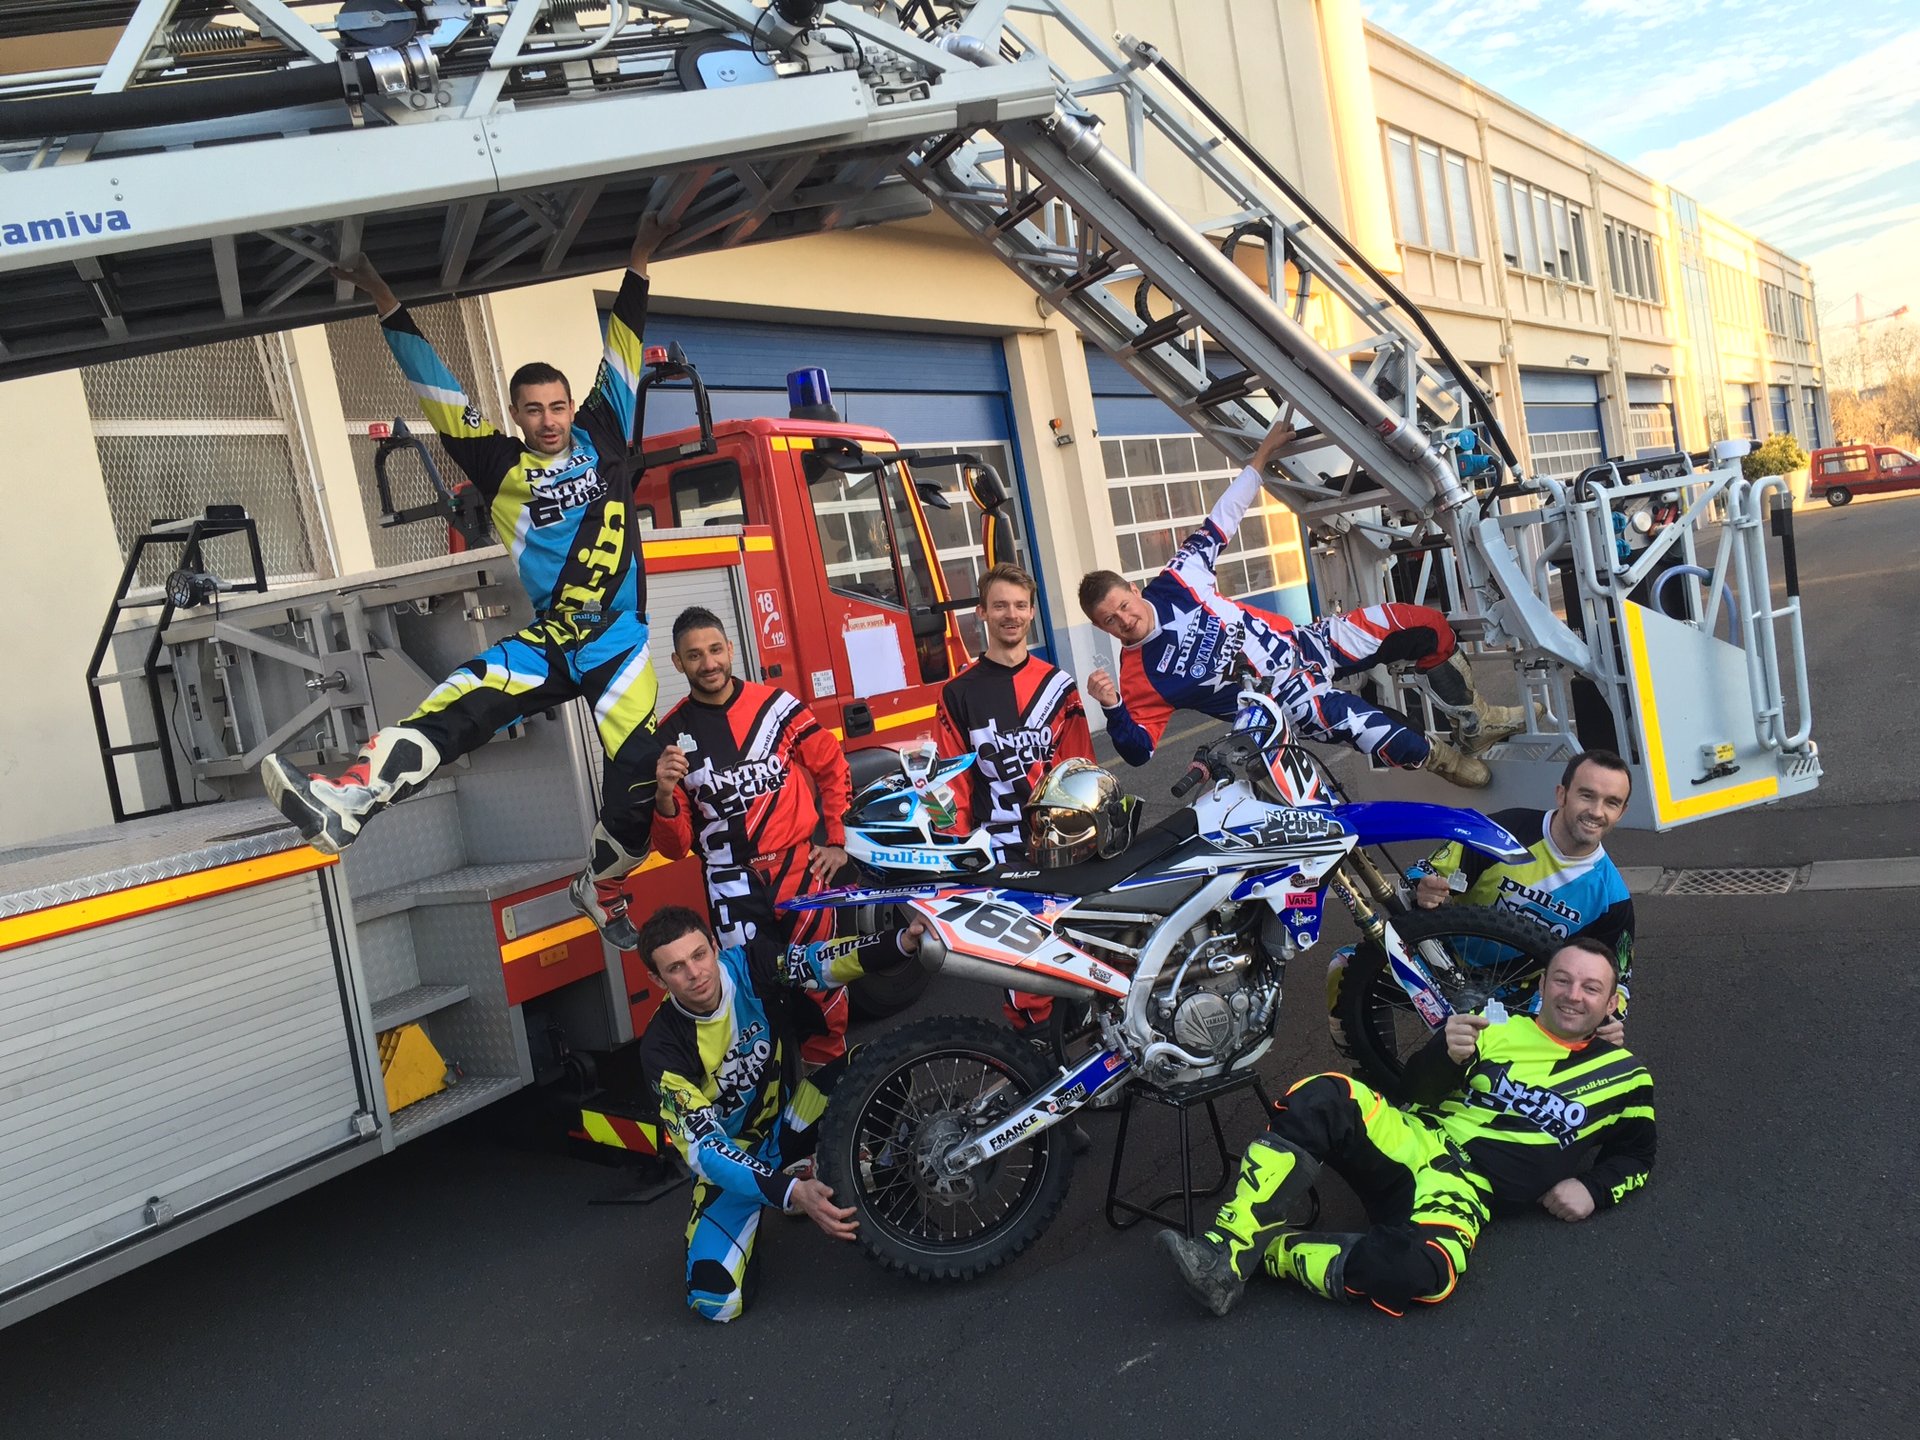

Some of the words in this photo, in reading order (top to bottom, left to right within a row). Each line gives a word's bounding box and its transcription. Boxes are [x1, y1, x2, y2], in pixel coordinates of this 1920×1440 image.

[0, 210, 131, 246] amiva
[531, 467, 597, 500] NITRO
[758, 592, 774, 613] 18
[771, 632, 785, 645] 112
[1194, 614, 1221, 664] YAMAHA
[1212, 623, 1238, 673] NITRO
[995, 726, 1053, 751] NITRO
[711, 754, 783, 791] NITRO
[1283, 820, 1330, 836] CUBE
[870, 849, 941, 867] pull-in
[869, 884, 932, 896] MICHELIN
[1288, 894, 1314, 906] VANS
[1496, 875, 1581, 924] pull-in
[935, 896, 1052, 953] 765
[713, 1038, 771, 1092] NTRO
[1056, 1083, 1085, 1107] IPONE
[1575, 1077, 1610, 1095] pull-in
[989, 1113, 1039, 1148] FRANCE
[993, 1128, 1029, 1152] EQUIPEMENT
